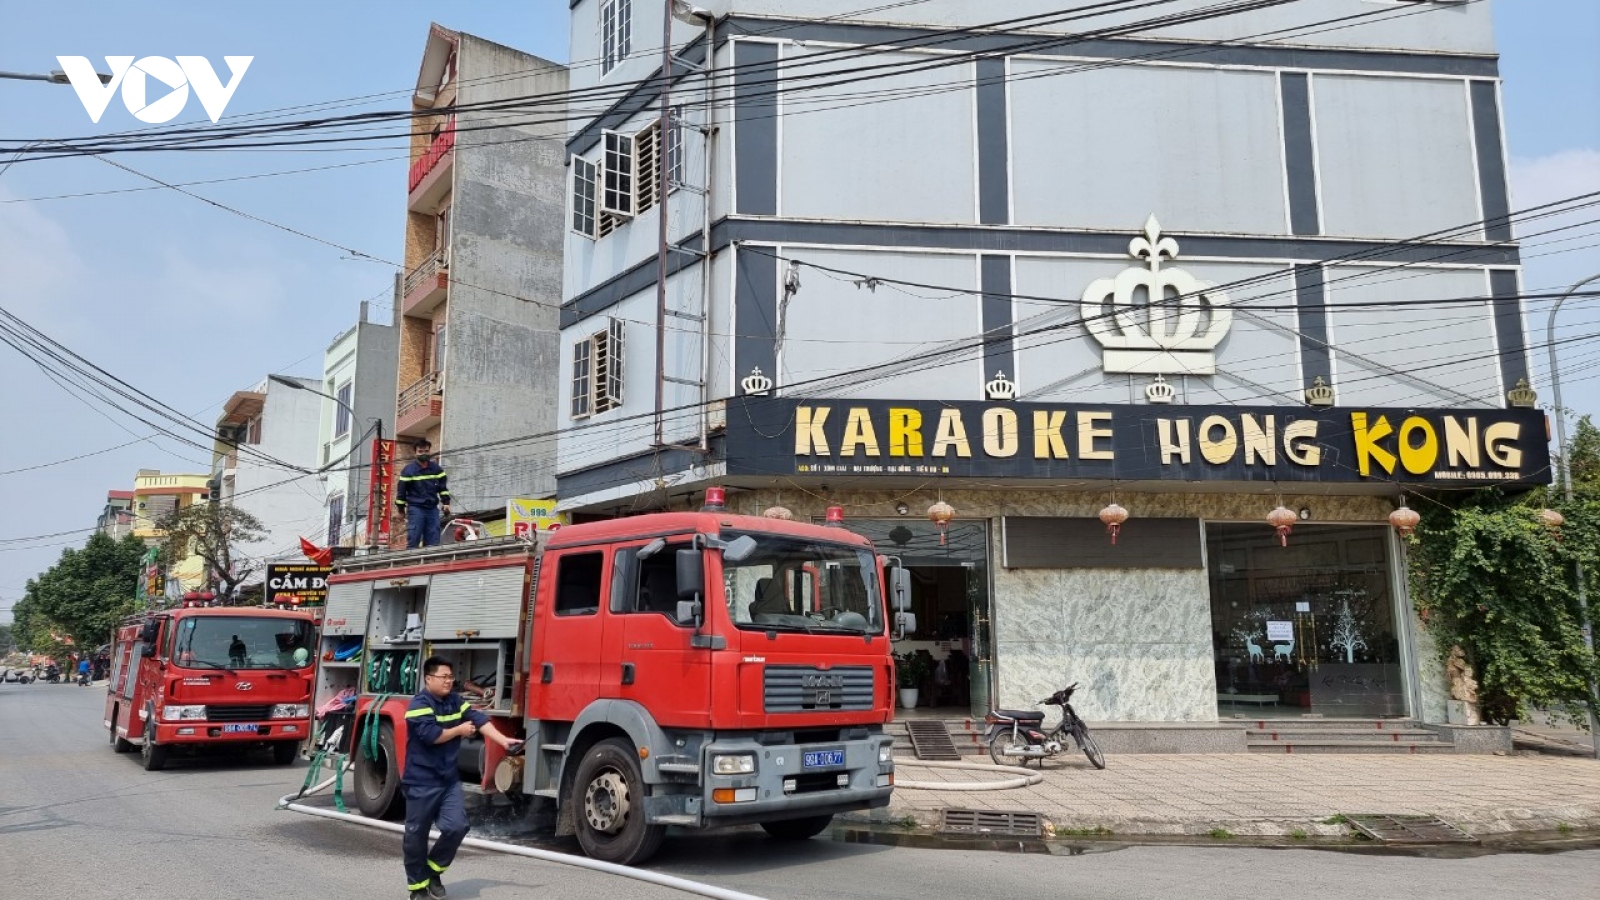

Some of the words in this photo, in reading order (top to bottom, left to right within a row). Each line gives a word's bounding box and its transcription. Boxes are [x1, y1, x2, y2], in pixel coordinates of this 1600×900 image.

[795, 406, 1115, 460] KARAOKE
[1157, 412, 1322, 467] HONG
[1350, 411, 1522, 476] KONG
[530, 508, 547, 517] 999
